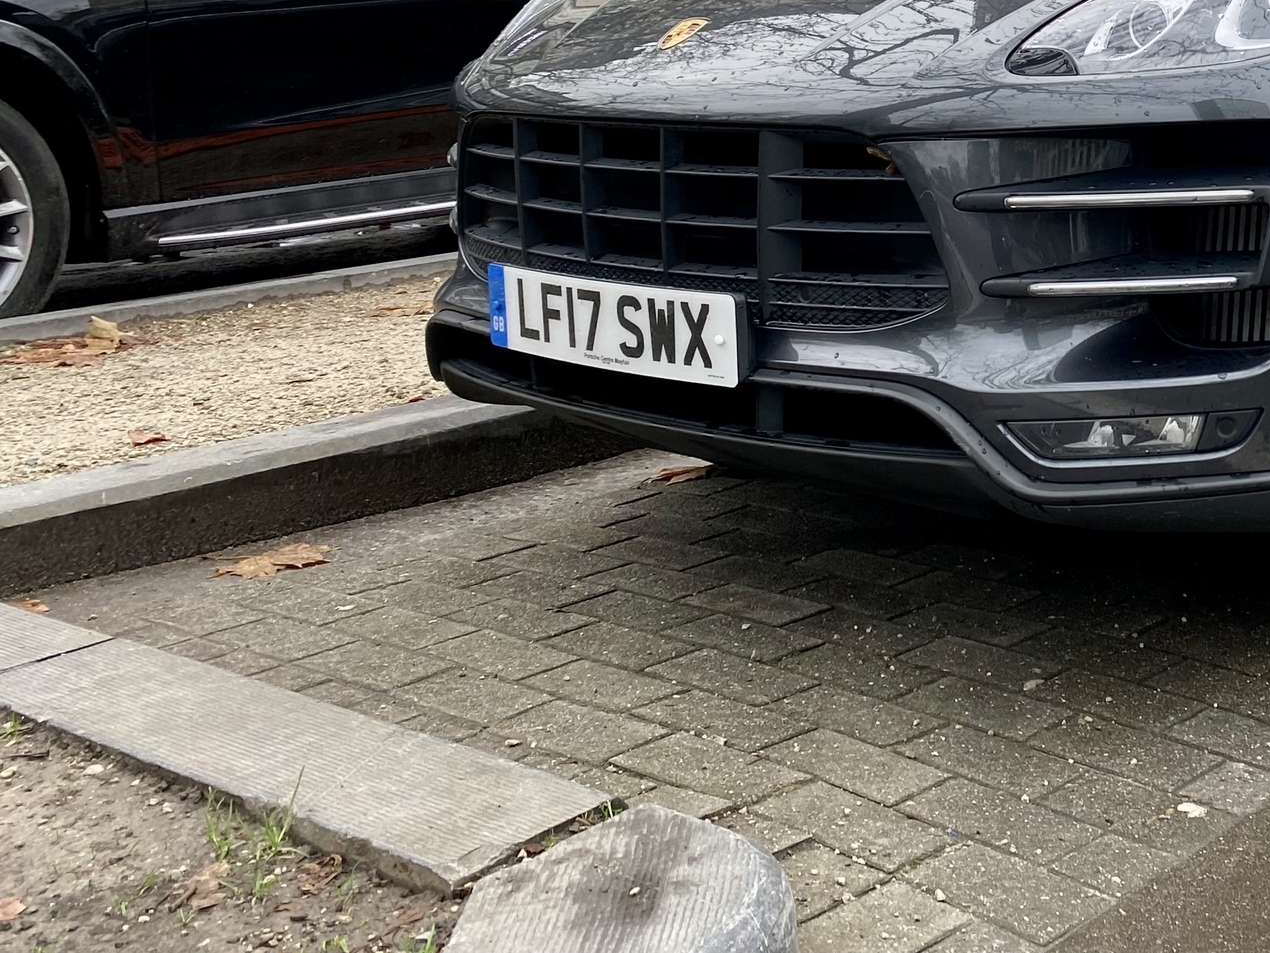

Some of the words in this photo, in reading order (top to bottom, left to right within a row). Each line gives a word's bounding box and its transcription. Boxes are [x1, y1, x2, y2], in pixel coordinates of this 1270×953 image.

[493, 315, 505, 333] GB
[516, 278, 601, 351] LF17
[616, 294, 713, 369] SWX
